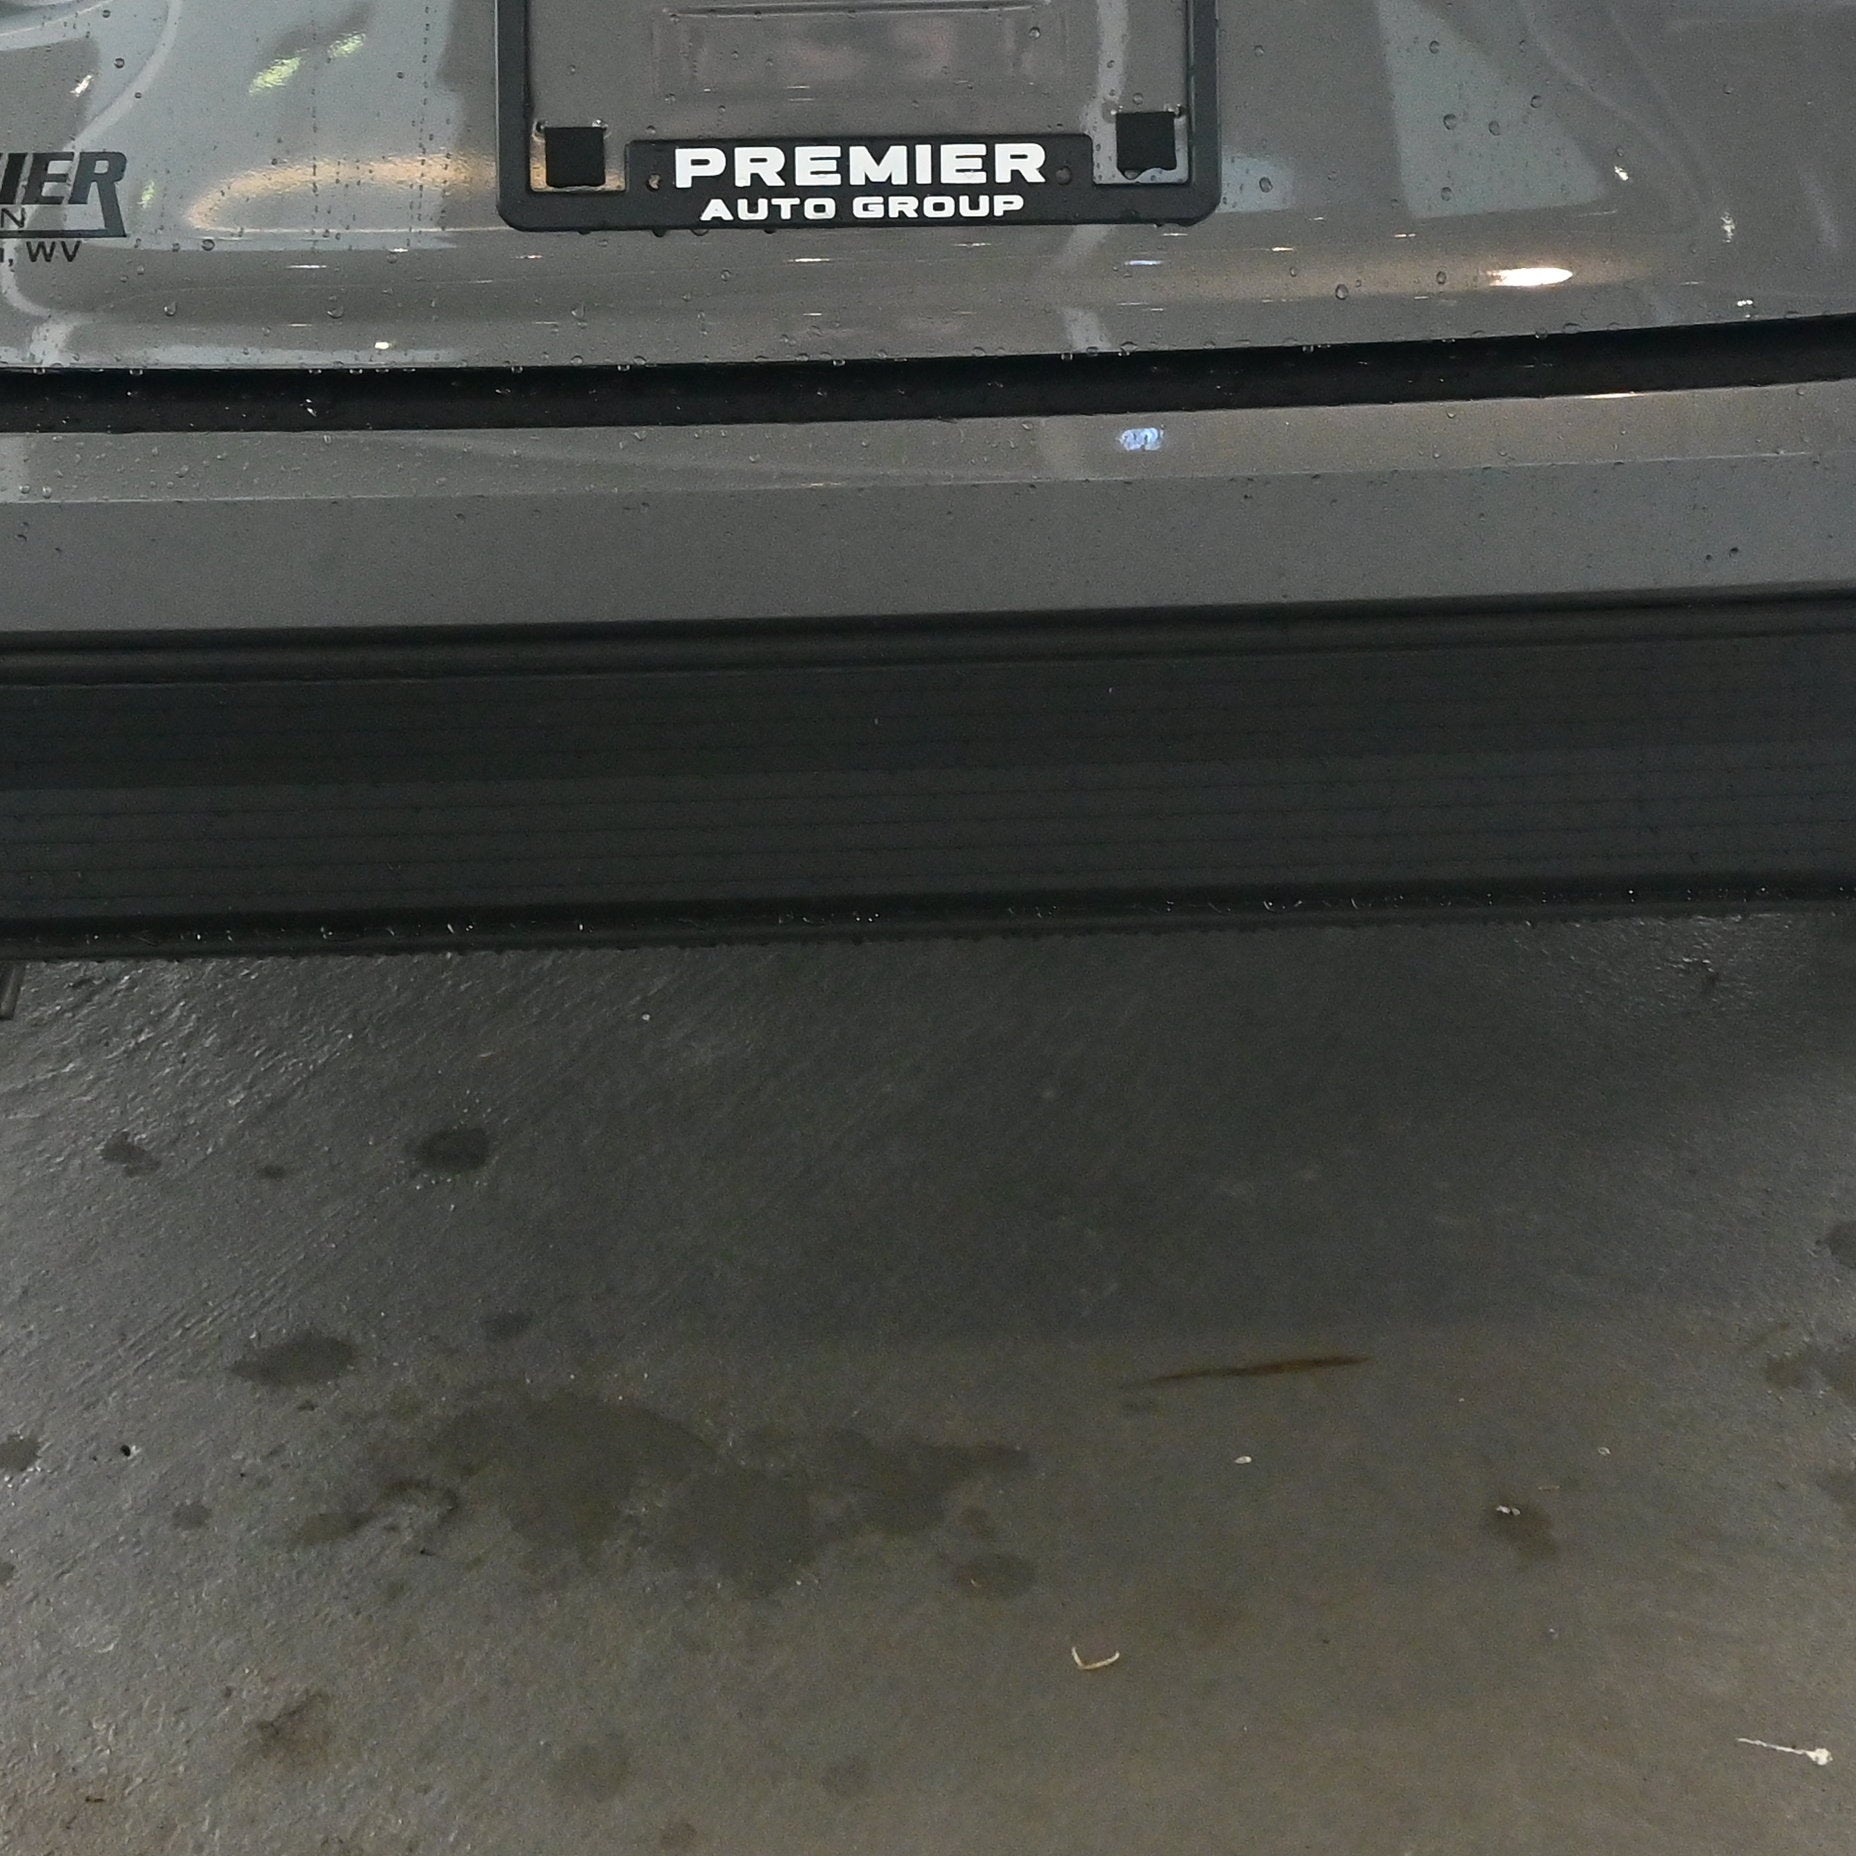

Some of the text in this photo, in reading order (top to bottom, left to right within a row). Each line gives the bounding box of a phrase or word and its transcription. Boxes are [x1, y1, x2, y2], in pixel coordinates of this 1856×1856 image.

[674, 142, 1047, 189] PREMIER
[699, 193, 1025, 222] AUTO GROUP
[25, 240, 83, 262] WV
